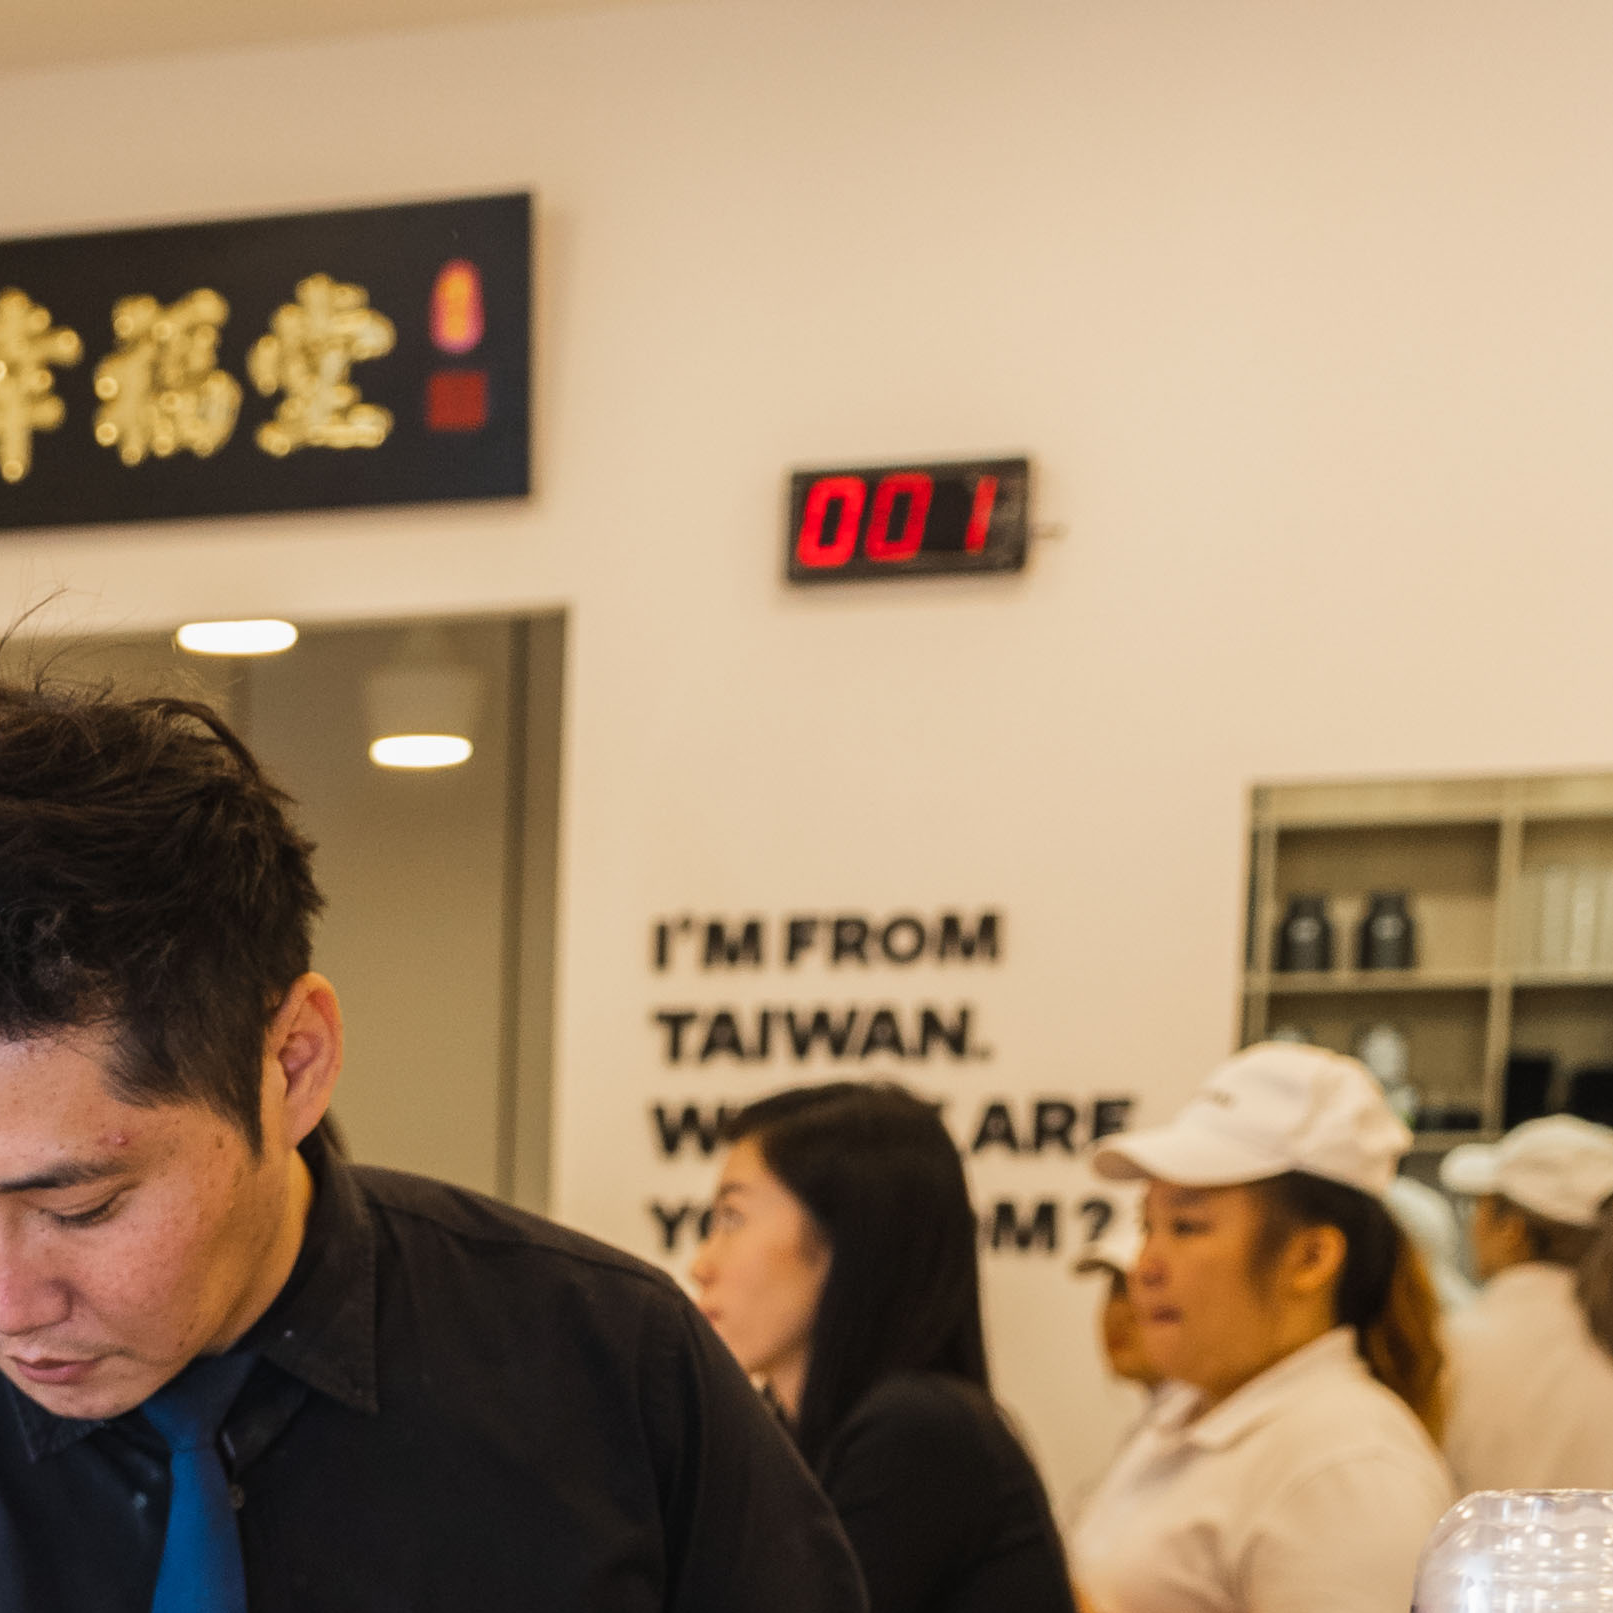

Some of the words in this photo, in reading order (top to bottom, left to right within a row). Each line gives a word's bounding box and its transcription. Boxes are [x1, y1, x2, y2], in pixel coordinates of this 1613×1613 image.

[796, 471, 1000, 569] 001
[652, 916, 764, 970] I'M
[786, 910, 1003, 964] FROM
[654, 1008, 992, 1062] TAIWAN.
[970, 1099, 1134, 1154] ARE
